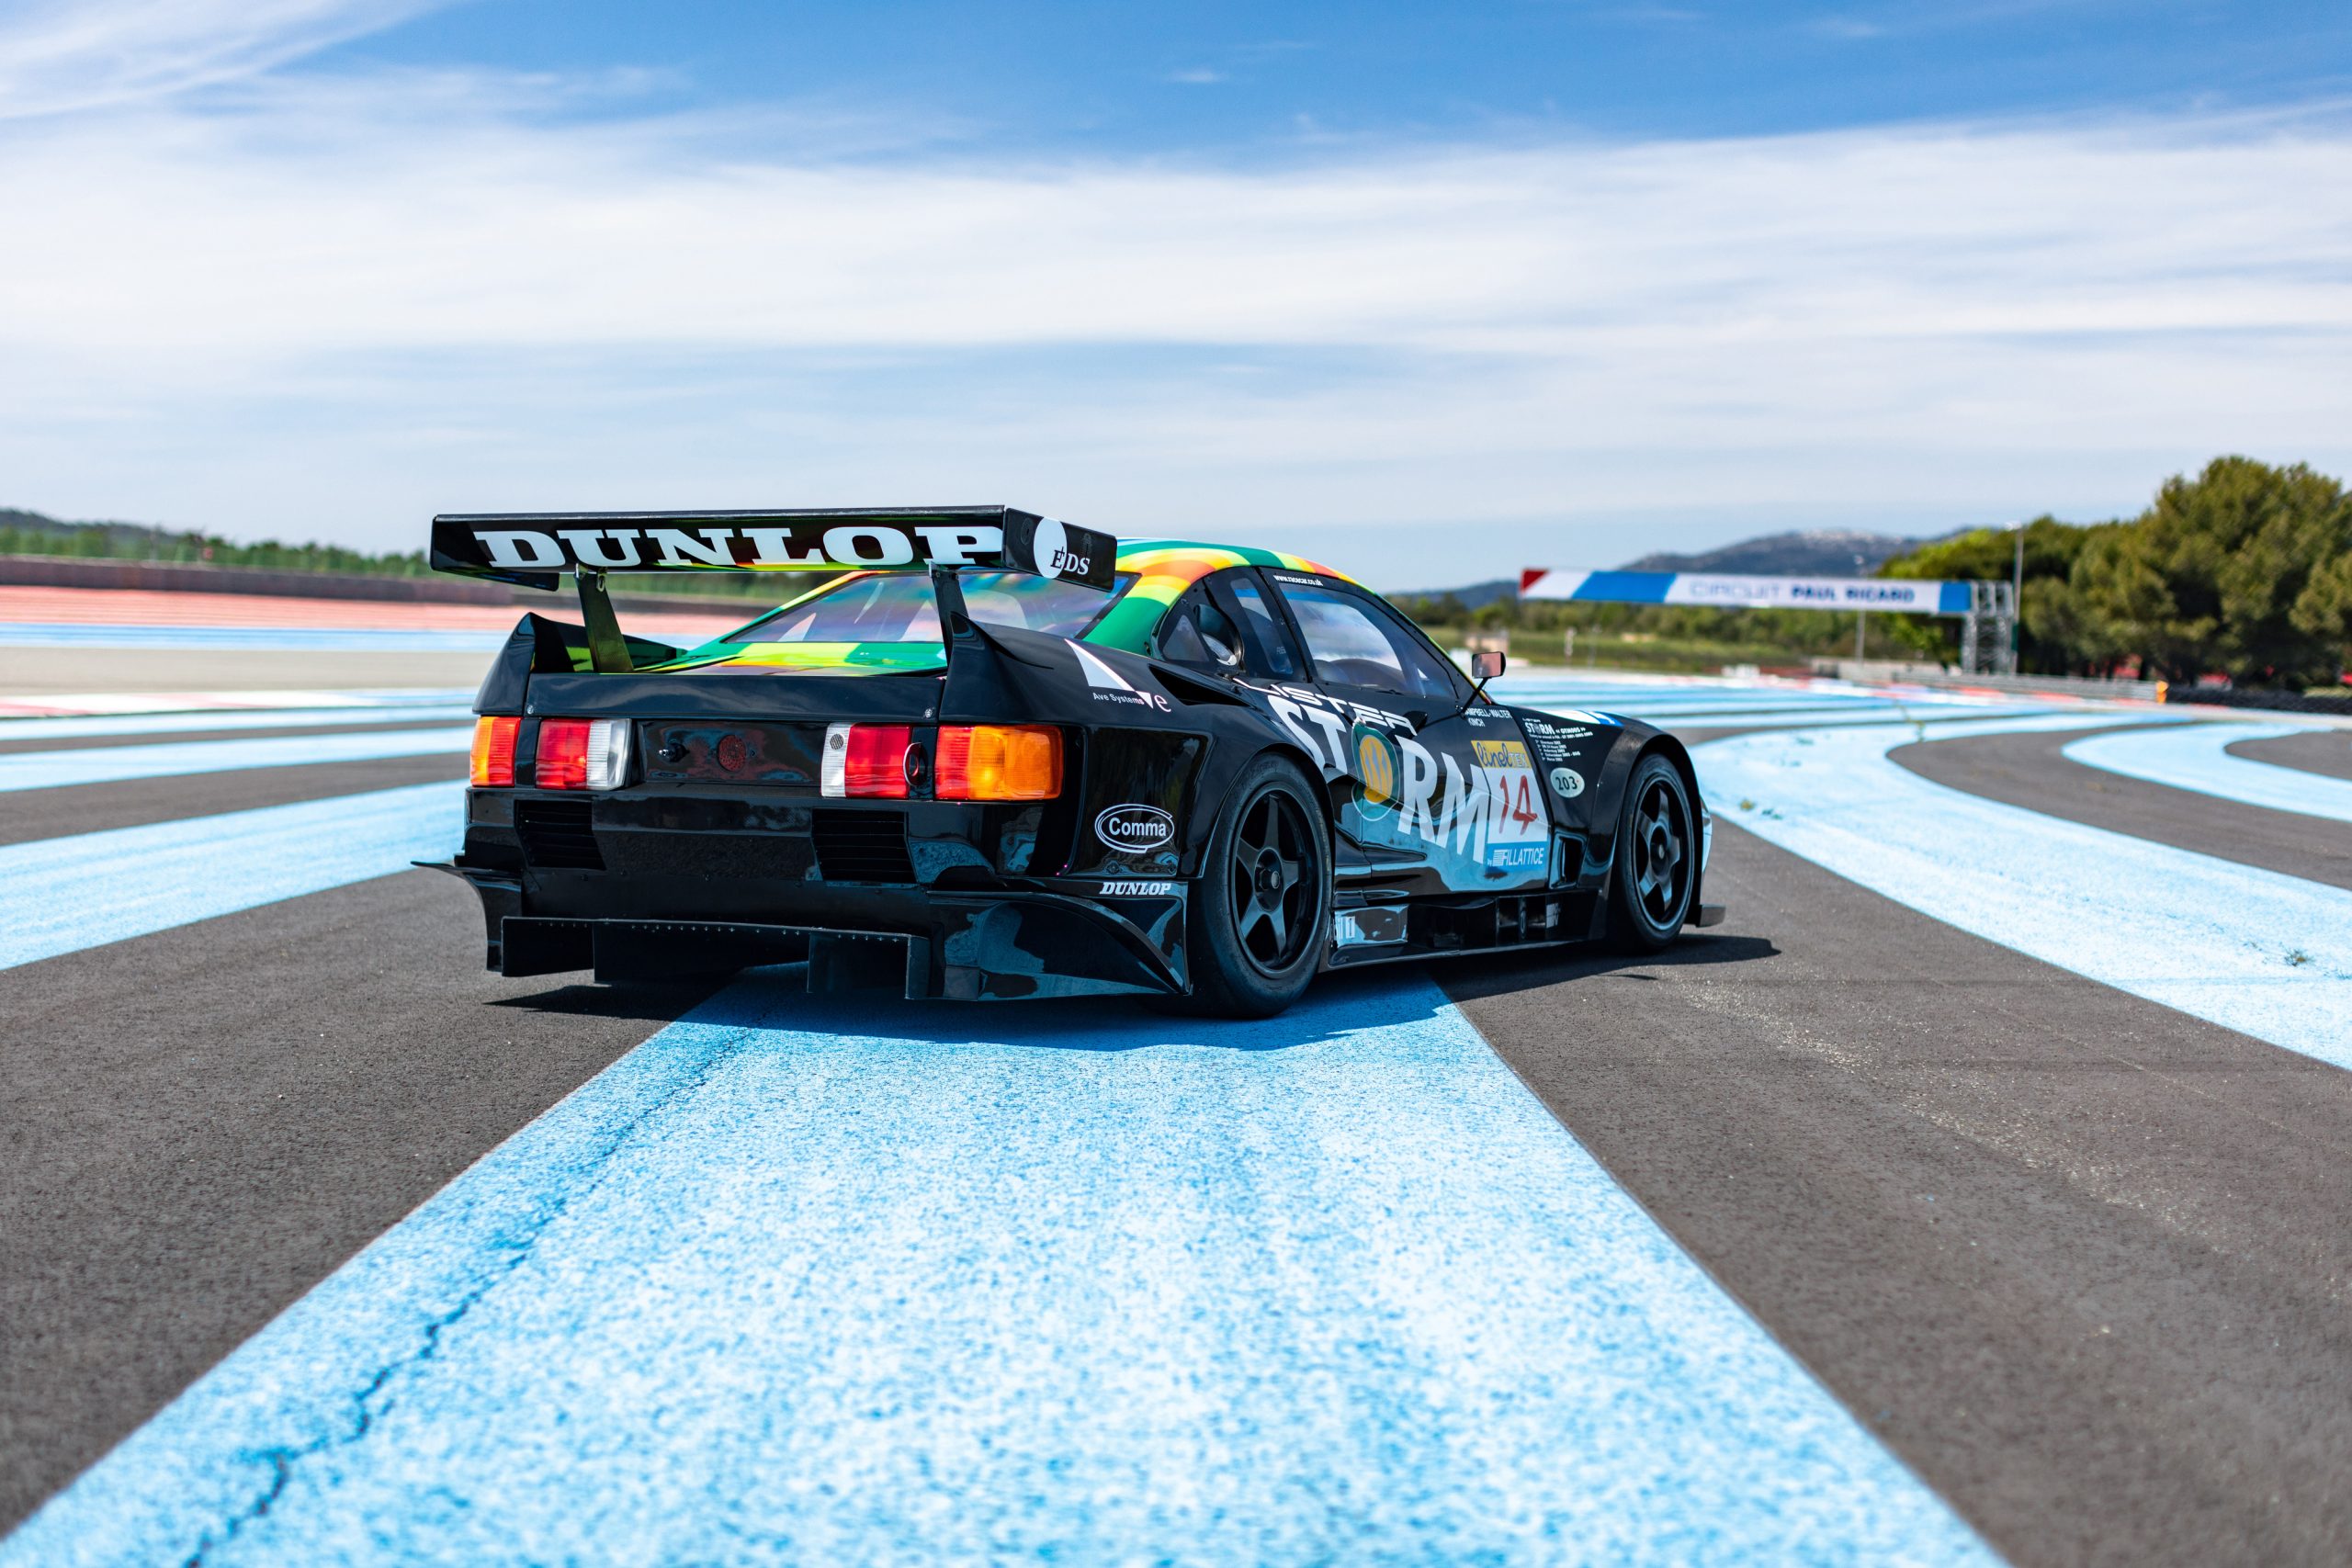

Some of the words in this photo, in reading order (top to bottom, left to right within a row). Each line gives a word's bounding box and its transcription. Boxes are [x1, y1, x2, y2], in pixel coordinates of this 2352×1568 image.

[473, 525, 1003, 567] DUNLOP
[1050, 547, 1090, 575] EDS
[1690, 581, 1781, 600] CIRCUIT
[1792, 583, 1837, 602] PAUL
[1846, 585, 1916, 604] RICARD
[1109, 694, 1145, 705] Systems
[1231, 677, 1418, 736] LISTER
[1555, 776, 1577, 790] 203
[1498, 774, 1538, 836] 14
[1108, 817, 1167, 837] Comma
[1495, 847, 1544, 866] FILLATTICE
[1099, 881, 1171, 896] DUNLOP
